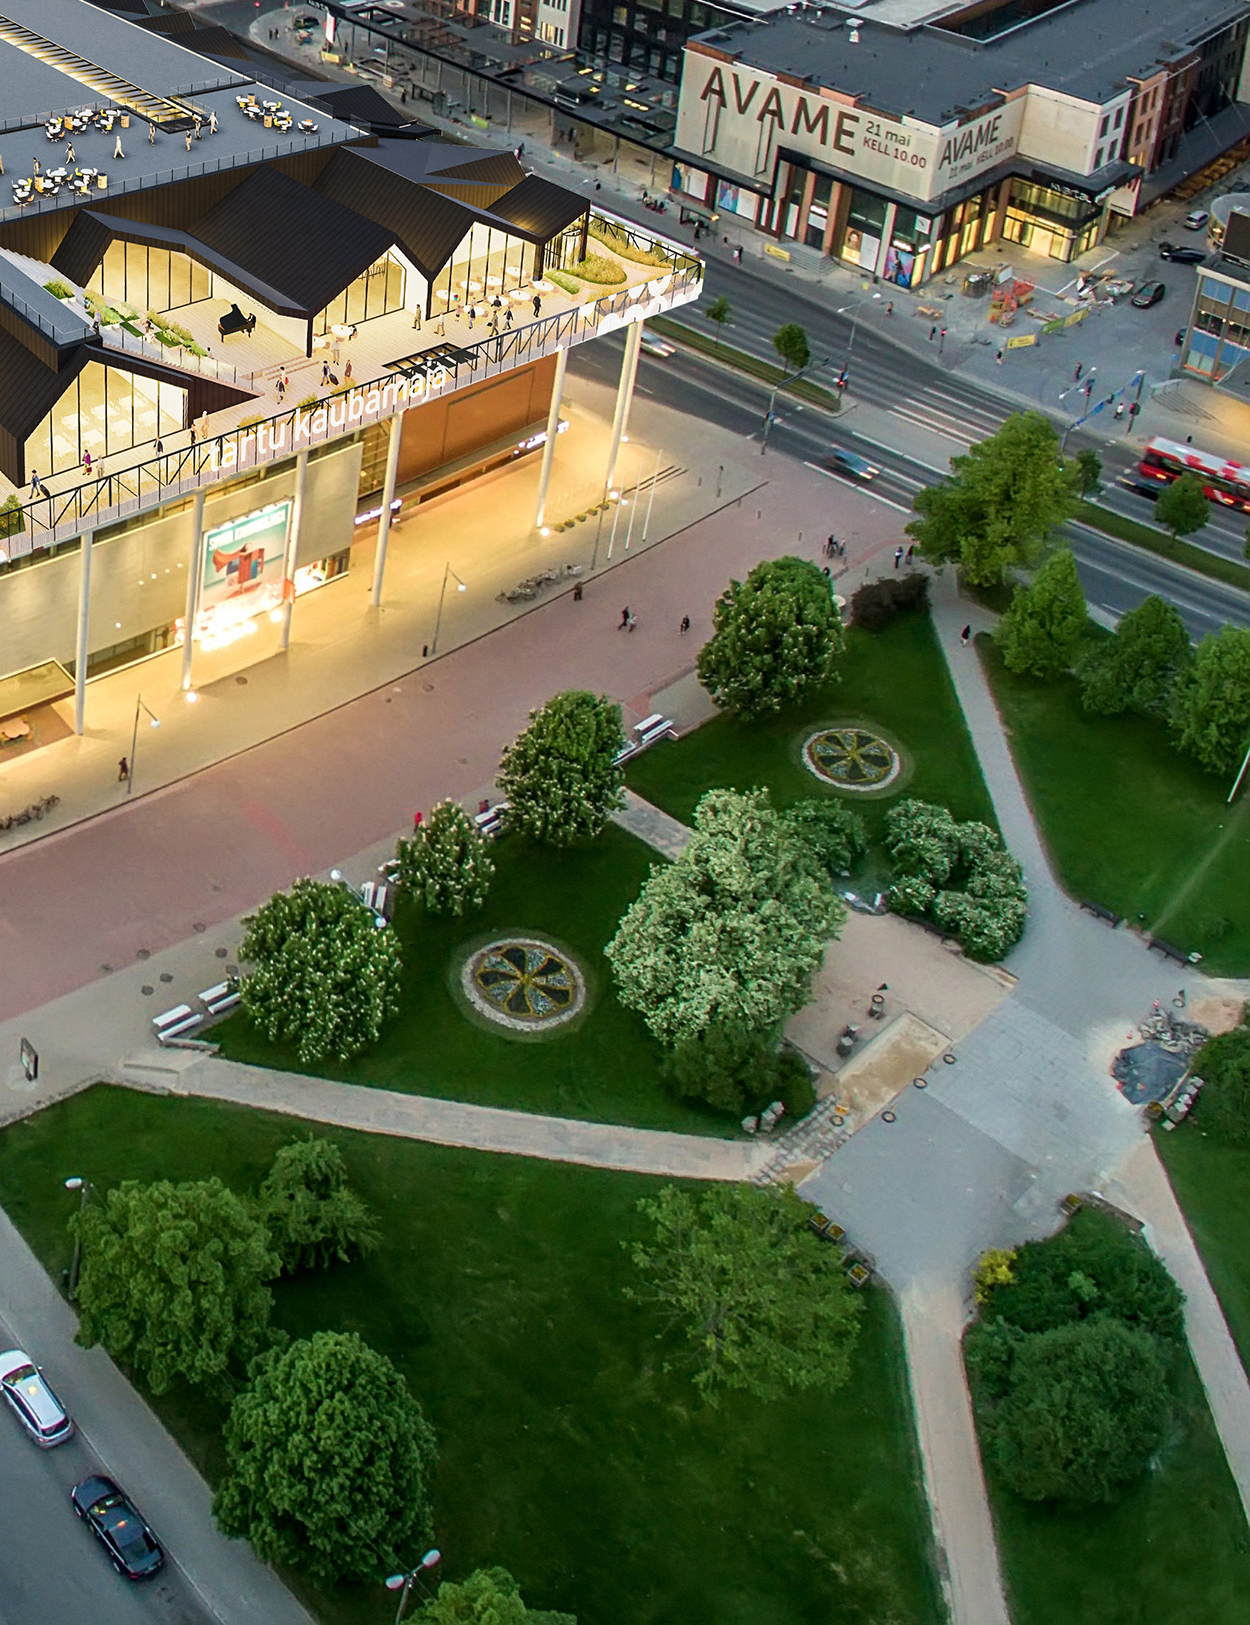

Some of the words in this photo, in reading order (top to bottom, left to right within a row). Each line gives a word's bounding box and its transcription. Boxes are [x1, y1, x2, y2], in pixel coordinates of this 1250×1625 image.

[700, 66, 860, 157] AVAME
[865, 120, 881, 138] 21
[884, 130, 912, 148] mai
[862, 136, 890, 157] KELL
[894, 147, 927, 169] 10.00
[937, 114, 1002, 170] AVAME
[208, 421, 286, 473] tartu
[294, 354, 447, 443] kaubamaja
